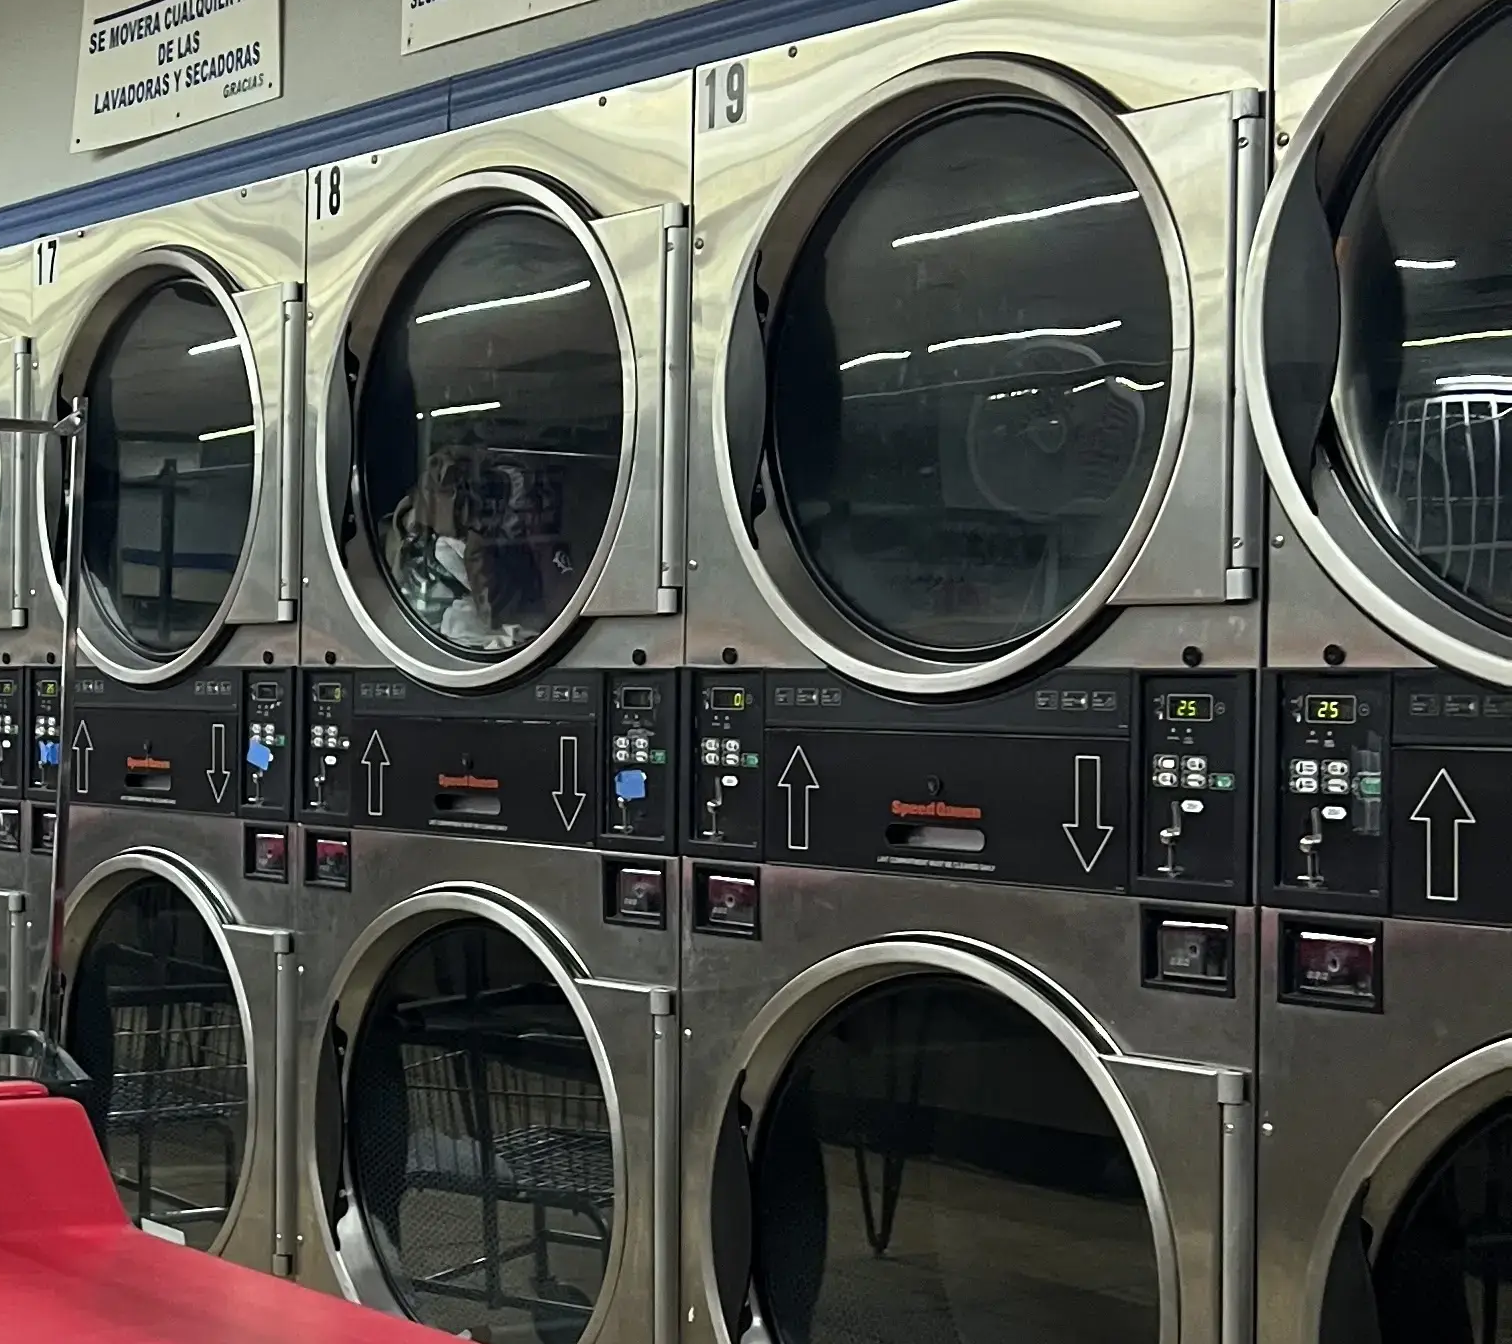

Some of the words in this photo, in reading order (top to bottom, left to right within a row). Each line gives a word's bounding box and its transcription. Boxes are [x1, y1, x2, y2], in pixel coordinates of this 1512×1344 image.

[89, 28, 105, 54] SE
[109, 12, 160, 49] MOVERA
[158, 42, 174, 66] DE
[177, 30, 200, 61] LAS
[94, 72, 170, 115] LAVADORAS
[174, 68, 182, 92] Y
[185, 42, 260, 88] SECADORAS
[223, 73, 264, 98] GRACIAS
[704, 63, 744, 129] 19
[314, 166, 341, 220] 18
[37, 241, 57, 285] 17
[1176, 700, 1197, 717] 25
[1317, 701, 1339, 719] 25
